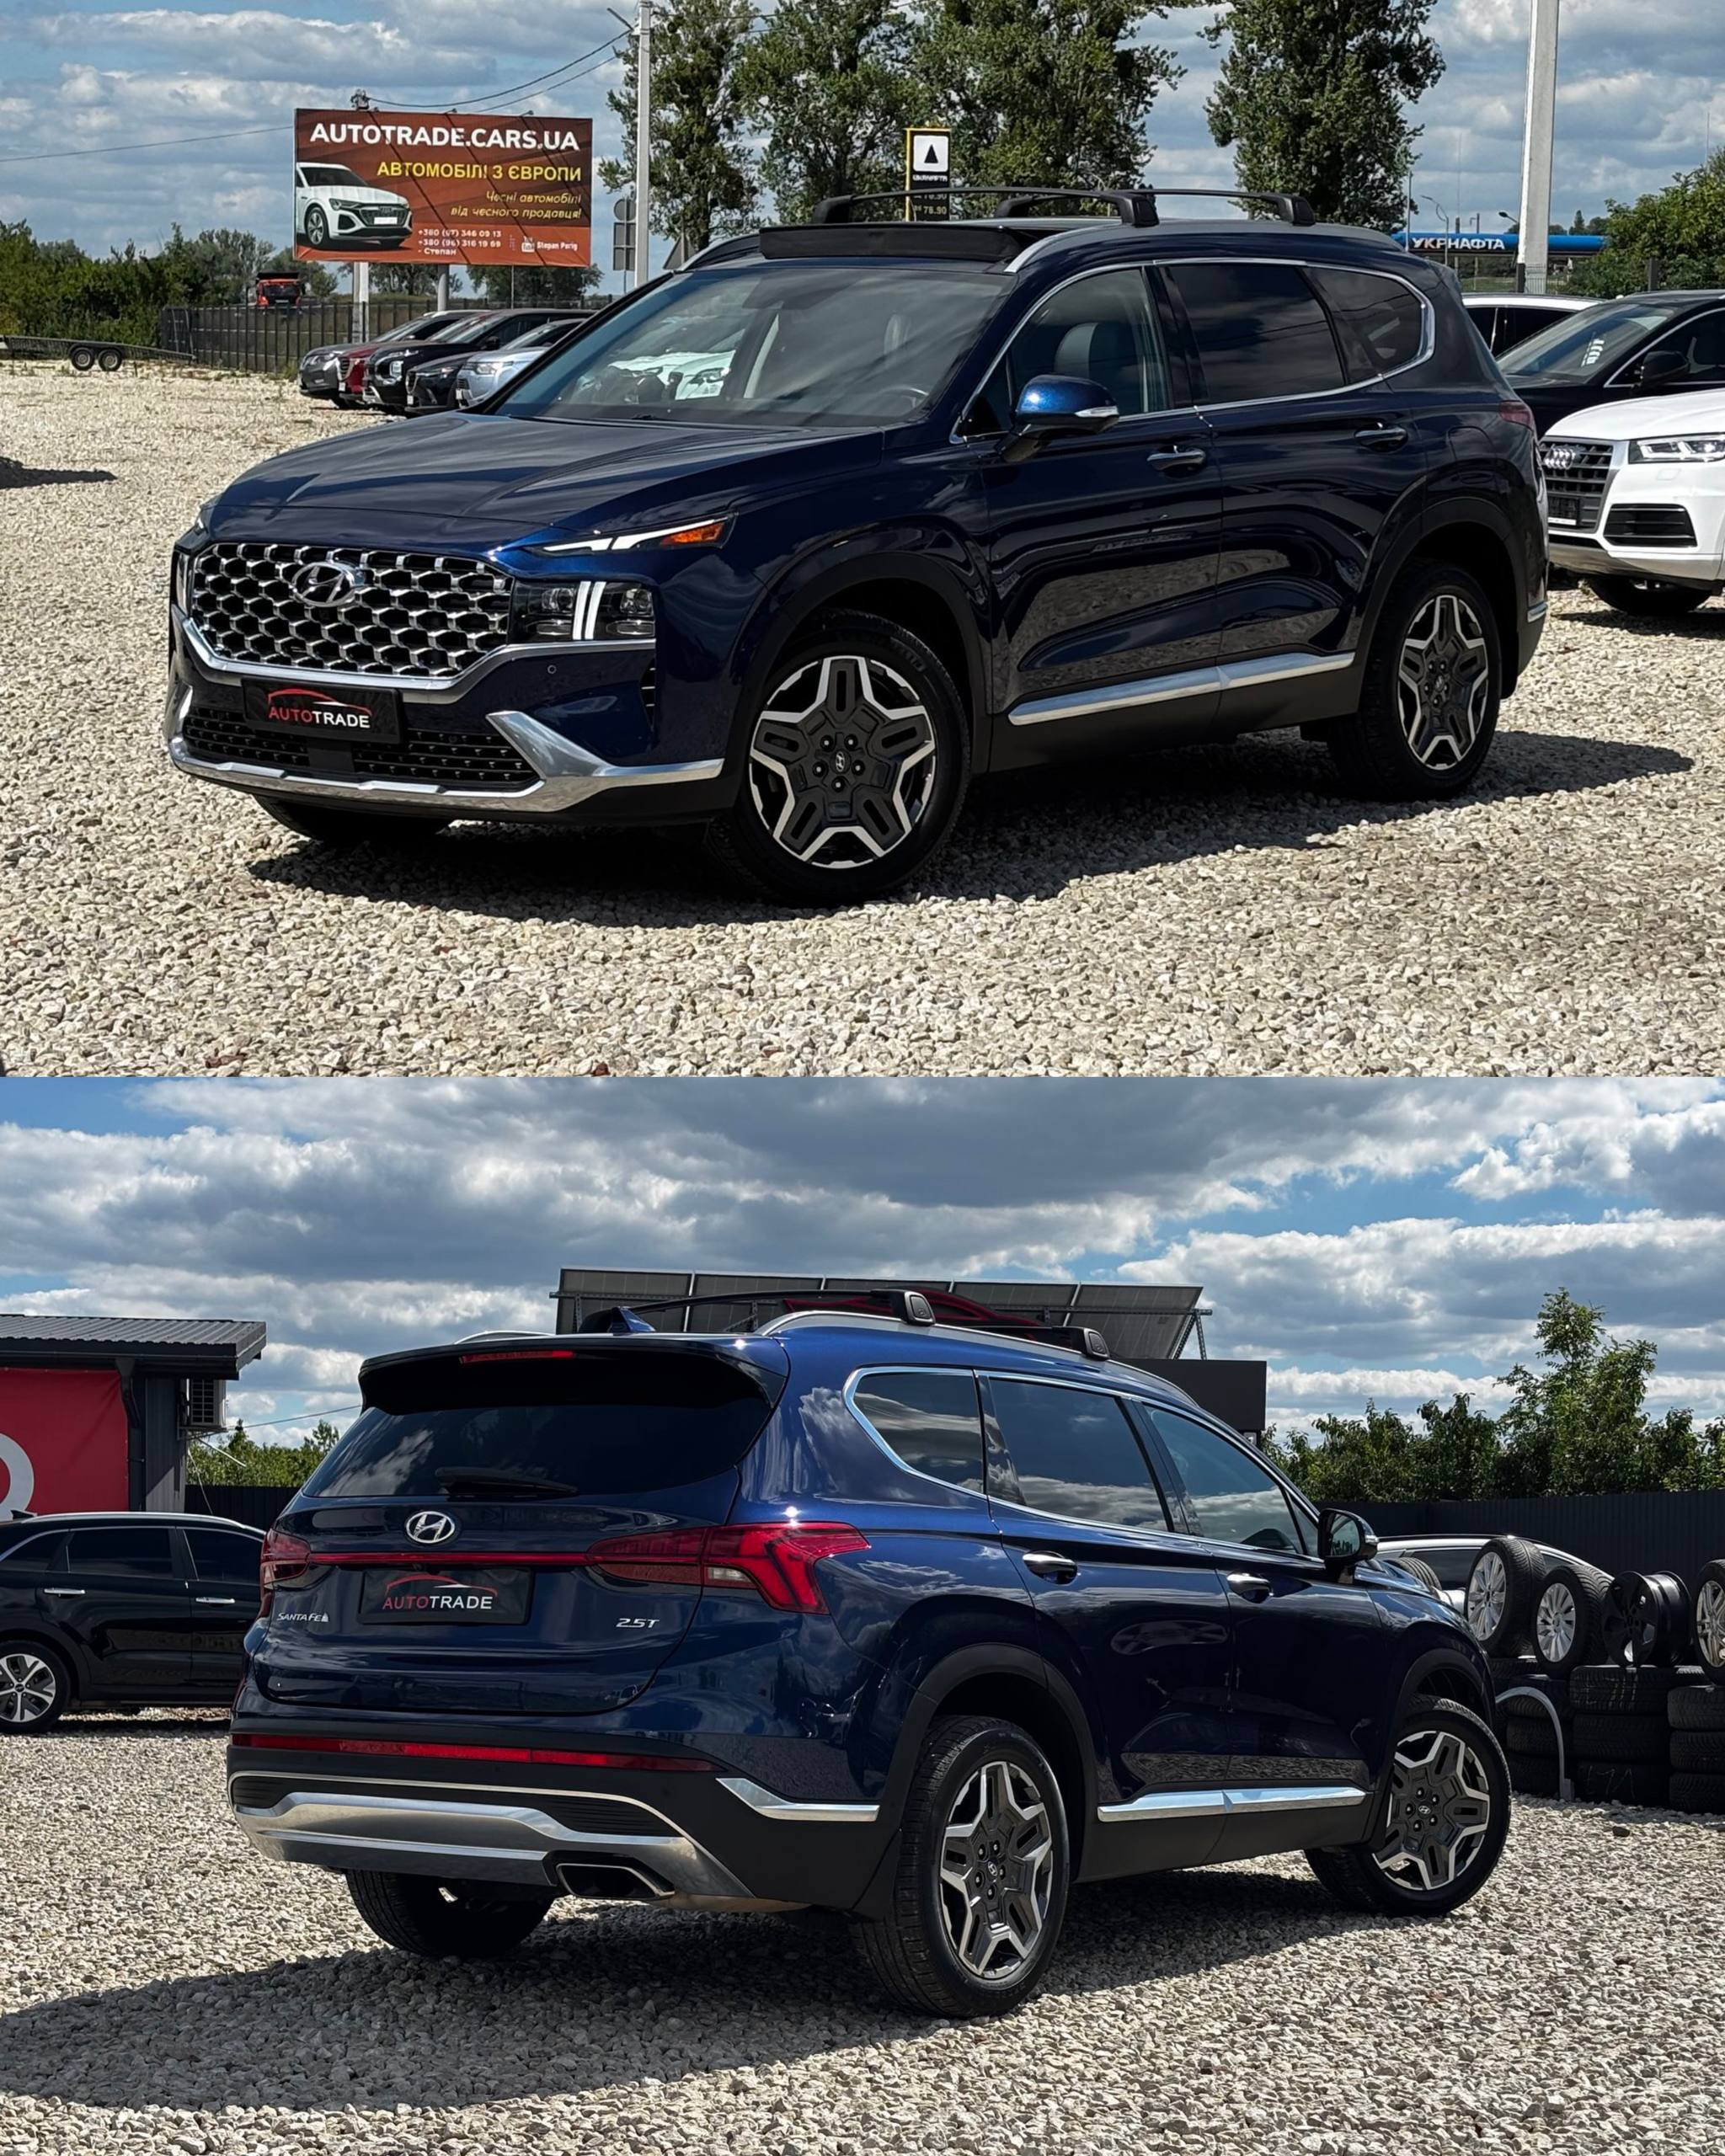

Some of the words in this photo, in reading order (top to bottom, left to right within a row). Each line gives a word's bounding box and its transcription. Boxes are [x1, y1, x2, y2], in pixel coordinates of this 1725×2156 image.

[310, 123, 580, 151] AUTOTRADE.CARS.UA
[377, 162, 488, 179] АВТОМОБІЛІ
[507, 167, 582, 182] ЄВРОПИ
[520, 192, 581, 205] автомобілі
[451, 205, 468, 216] від
[473, 209, 520, 217] чесного
[418, 228, 440, 237] +380
[1412, 237, 1506, 250] УКРНАФТА
[269, 707, 371, 728] AUTOTRADE
[382, 1595, 494, 1609] AUTOTRADE
[276, 1612, 307, 1621] SANTA
